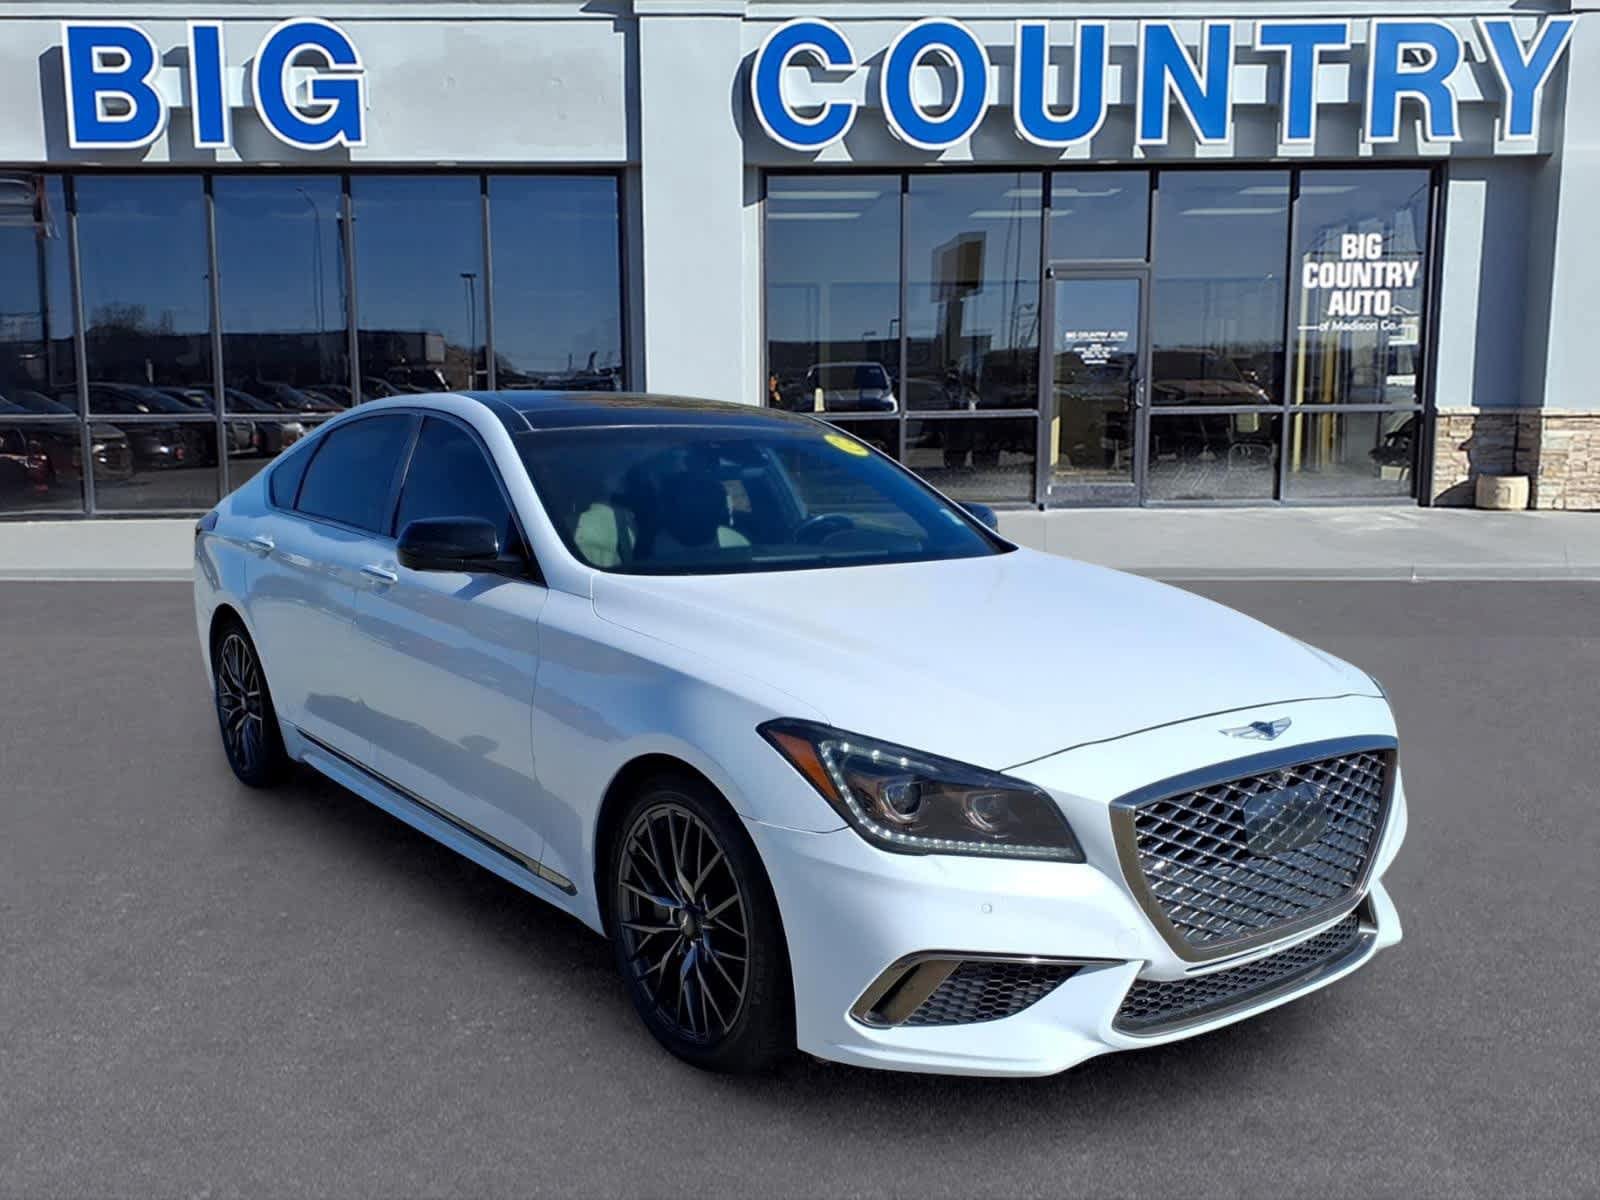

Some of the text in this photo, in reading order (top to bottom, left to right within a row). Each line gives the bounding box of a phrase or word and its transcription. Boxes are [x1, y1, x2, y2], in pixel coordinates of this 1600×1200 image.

[62, 14, 1576, 153] BIG COUNTRY
[1341, 232, 1383, 261] BIG
[1302, 260, 1420, 289] COUNTRY
[1327, 290, 1392, 317] AUTO
[1319, 320, 1330, 331] of
[1331, 320, 1378, 331] Madison
